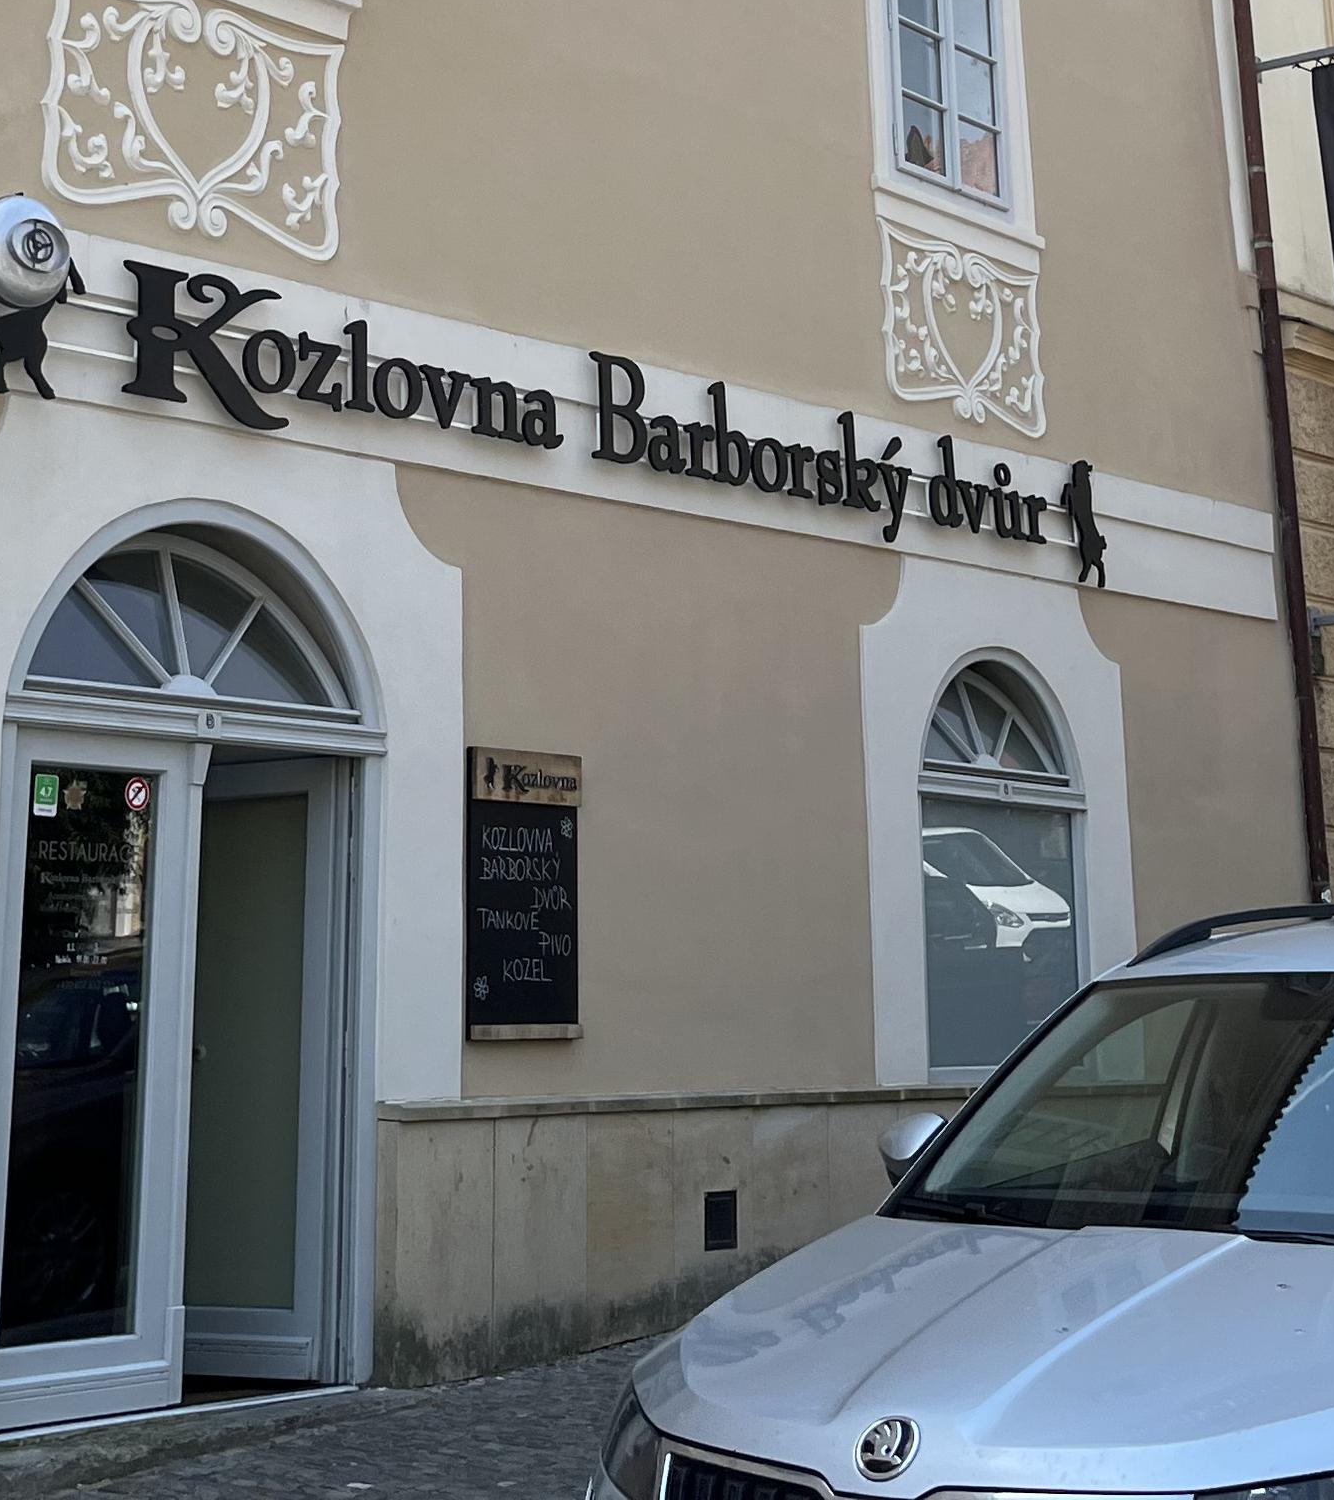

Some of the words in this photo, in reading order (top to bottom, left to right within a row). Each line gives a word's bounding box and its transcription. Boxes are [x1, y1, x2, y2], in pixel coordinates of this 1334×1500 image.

[123, 258, 564, 450] Kozlovna
[588, 350, 912, 543] Barborský
[929, 434, 1048, 545] dvůr
[502, 764, 577, 794] Kozlovna
[482, 824, 554, 851] KOZLOVNA
[479, 852, 560, 882] BARBORSKÝ
[531, 885, 572, 911] DVŮR
[477, 906, 540, 931] TANKOVÉ
[538, 931, 572, 956] PIVO
[502, 958, 553, 982] KOZEL
